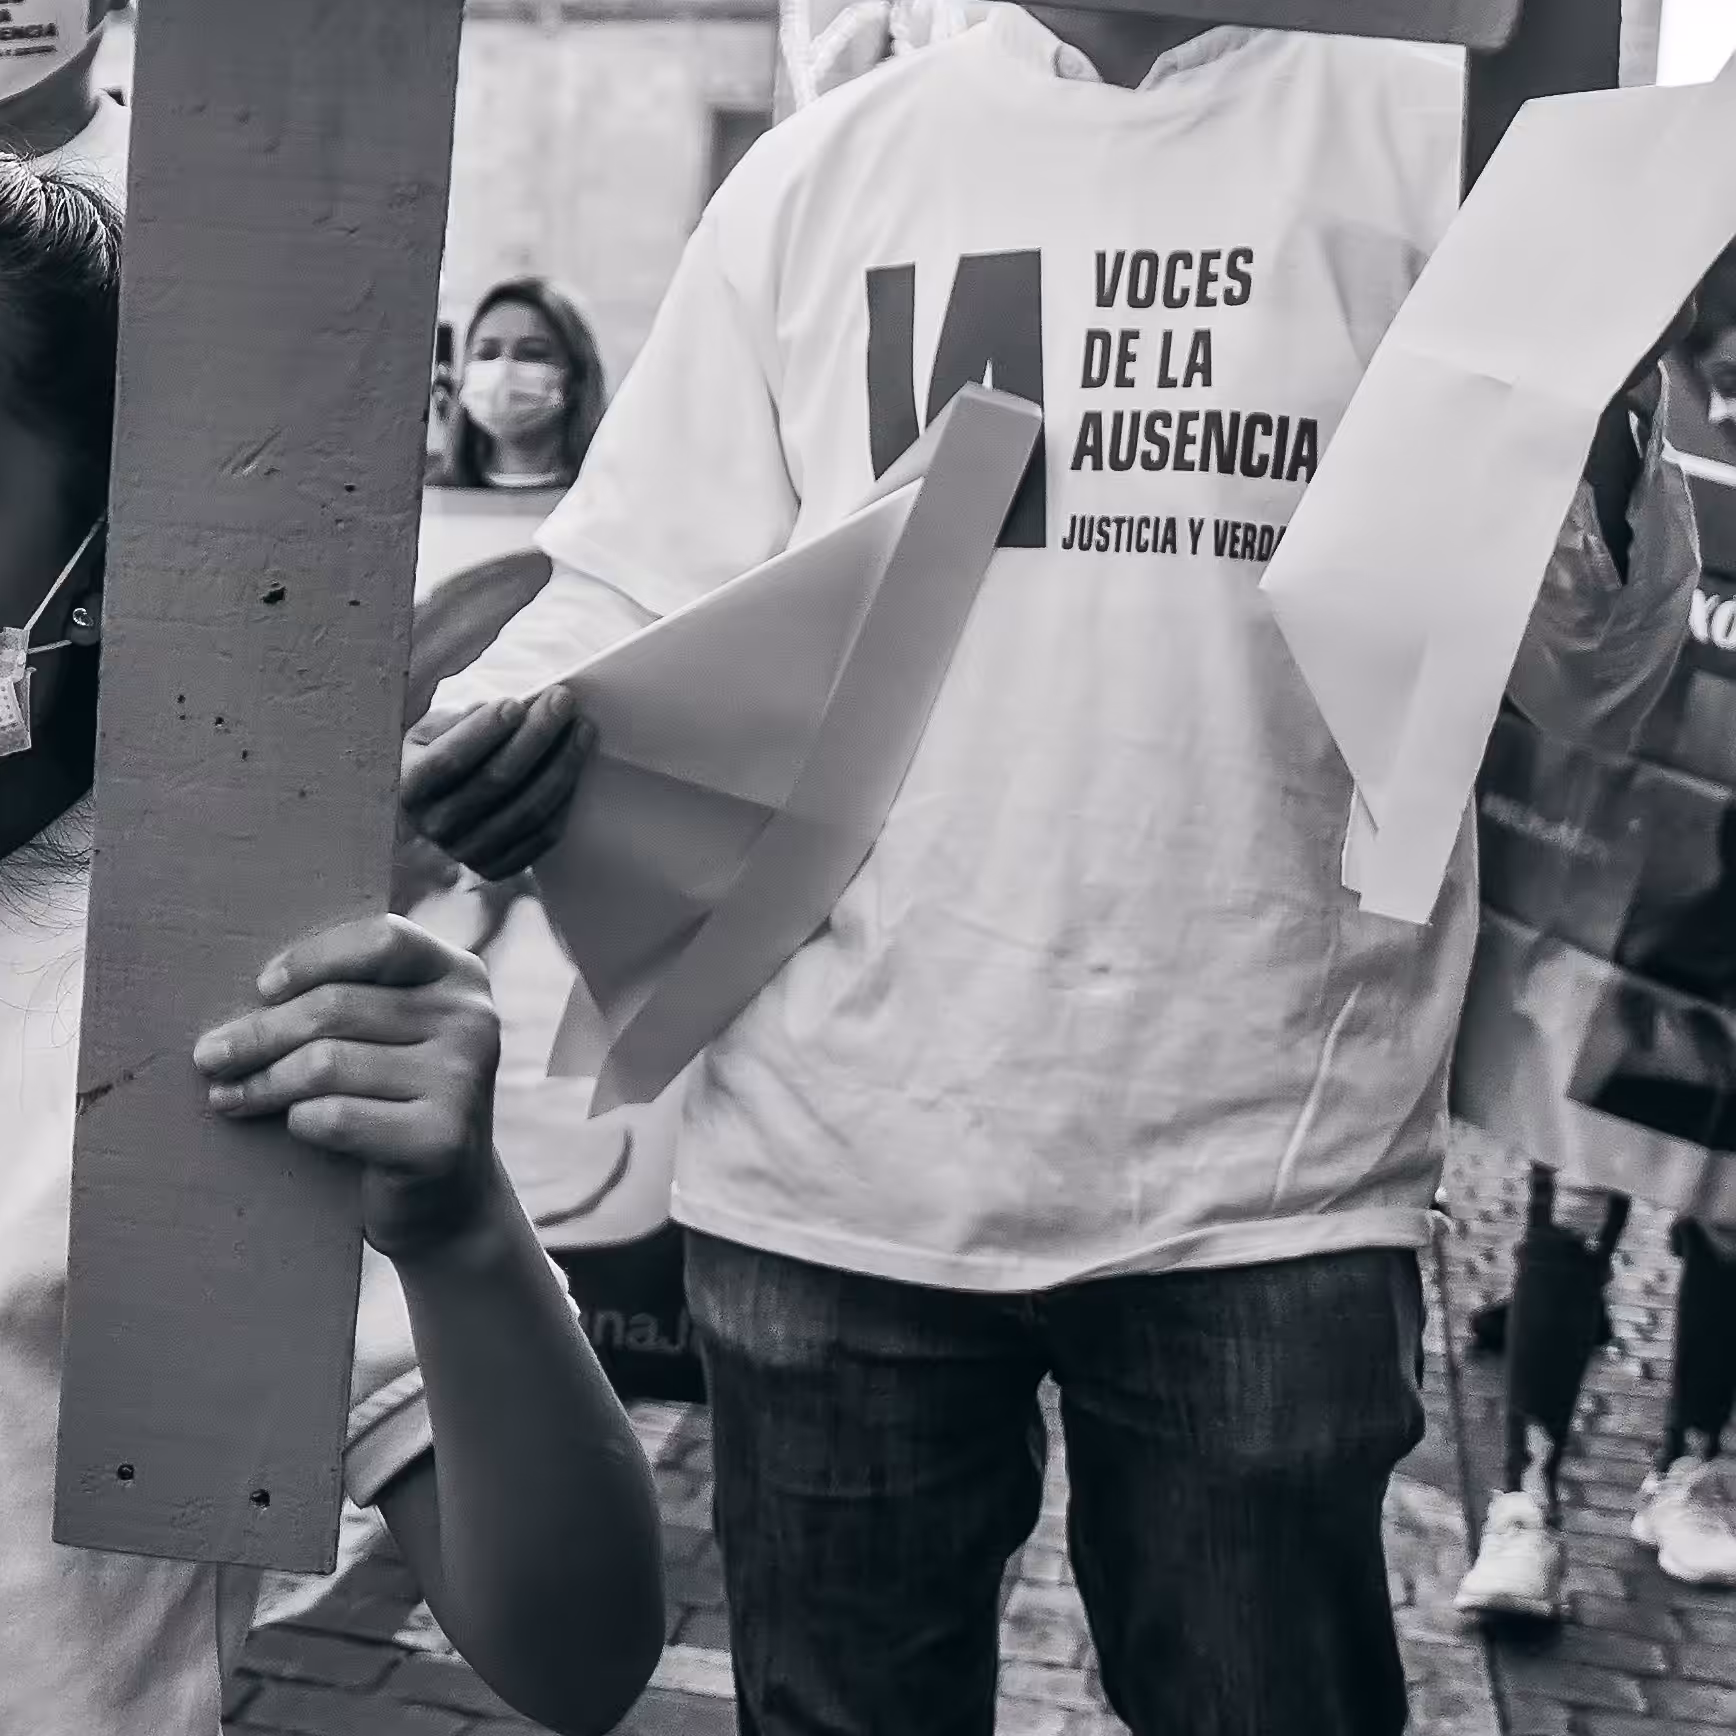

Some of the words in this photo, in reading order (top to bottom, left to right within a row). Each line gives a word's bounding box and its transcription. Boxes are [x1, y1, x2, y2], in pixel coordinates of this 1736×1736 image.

[1095, 247, 1254, 309] VOCES
[1080, 328, 1142, 389] DE
[1157, 328, 1213, 389] LA
[1070, 409, 1319, 484] AUSENCIA
[1061, 515, 1178, 554] JUSTICIA
[1188, 518, 1205, 556] Y
